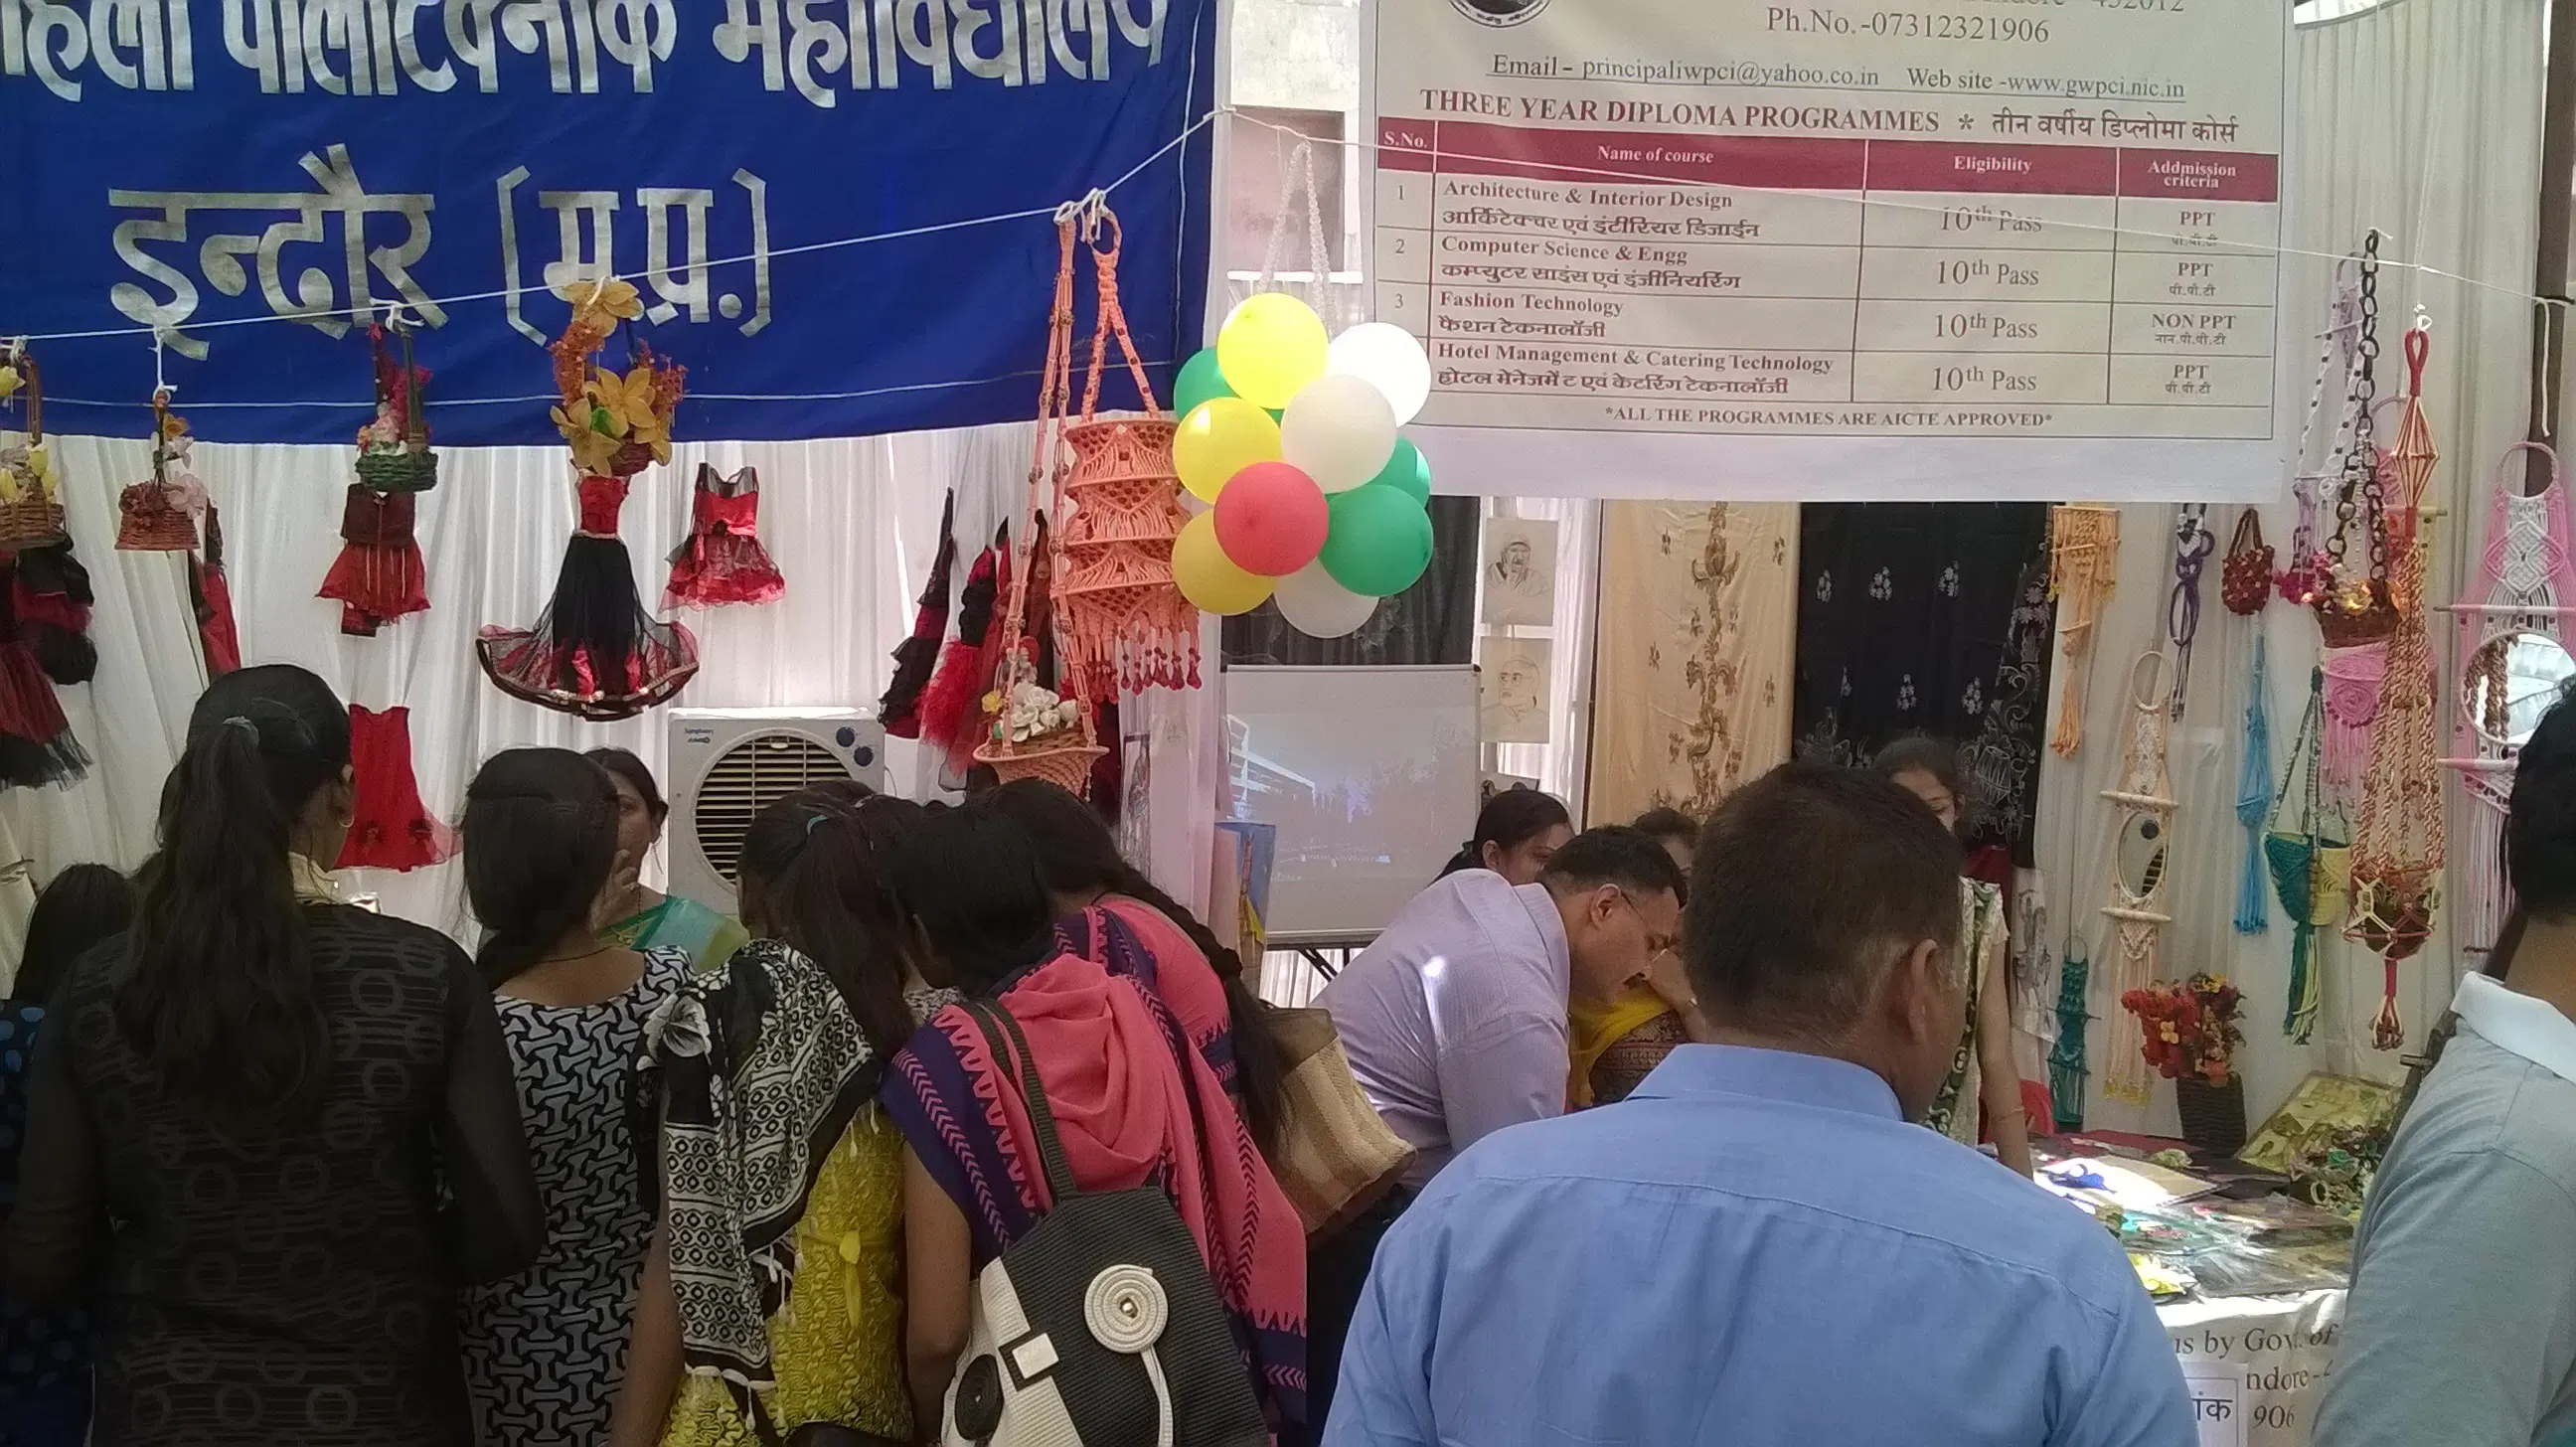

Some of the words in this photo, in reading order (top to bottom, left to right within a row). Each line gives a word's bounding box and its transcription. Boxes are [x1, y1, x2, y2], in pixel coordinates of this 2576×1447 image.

[1493, 54, 1557, 77] Email
[1582, 57, 1879, 87] principaliwpci@yahoo.co.in
[1907, 67, 1951, 88] Web
[1958, 70, 1993, 89] site
[1420, 89, 1511, 118] THREE
[1520, 97, 1598, 122] YEAR
[1607, 100, 1737, 127] DIPLOMA
[1745, 104, 1940, 132] PROGRAMMES
[1992, 106, 2032, 135] तीन
[2037, 108, 2096, 137] वर्षीय
[2101, 109, 2186, 140] डिप्लोमा
[2191, 113, 2239, 143] कोर्स
[1383, 130, 1428, 148] S.No.
[1598, 145, 1643, 163] Name
[1646, 147, 1664, 163] of
[1665, 150, 1714, 165] course
[1954, 155, 2032, 174] Eligibility
[2148, 159, 2237, 178] Addmission
[2164, 173, 2220, 189] criteria
[1398, 185, 1404, 201] 1
[1444, 180, 1559, 203] Architecture
[1565, 188, 1582, 204] &
[1590, 189, 1666, 207] Interior
[1670, 191, 1732, 212] Design
[1562, 215, 1589, 236] एवं
[1999, 210, 2043, 233] Pass
[2179, 211, 2216, 227] PPT
[108, 143, 449, 362] इन्दौर
[1395, 238, 1405, 254] 2
[1441, 236, 1539, 256] Computer
[1544, 241, 1610, 260] Science
[1615, 245, 1633, 261] &
[1639, 246, 1689, 266] Engg
[1592, 268, 1619, 288] एवं
[1996, 263, 2039, 285] Pass
[2177, 261, 2214, 277] PPT
[1394, 293, 1404, 309] 3
[1441, 291, 1516, 308] Fashion
[1522, 293, 1624, 318] Technology
[1992, 316, 2038, 339] Pass
[2152, 313, 2194, 329] NON
[2199, 315, 2237, 330] PPT
[1438, 343, 1490, 360] Hotel
[1496, 345, 1618, 366] Management
[1623, 350, 1640, 365] &
[1646, 350, 1726, 372] Catering
[1729, 354, 1835, 375] Technology
[1438, 367, 1492, 387] होटल
[1581, 373, 1608, 393] एवं
[1992, 369, 2037, 392] Pass
[2174, 364, 2209, 380] PPT
[1655, 408, 1692, 423] THE
[1698, 409, 1835, 425] PROGRAMMES
[1839, 411, 1876, 426] ARE
[1881, 412, 1939, 427] AICTE
[2204, 1330, 2234, 1360] by
